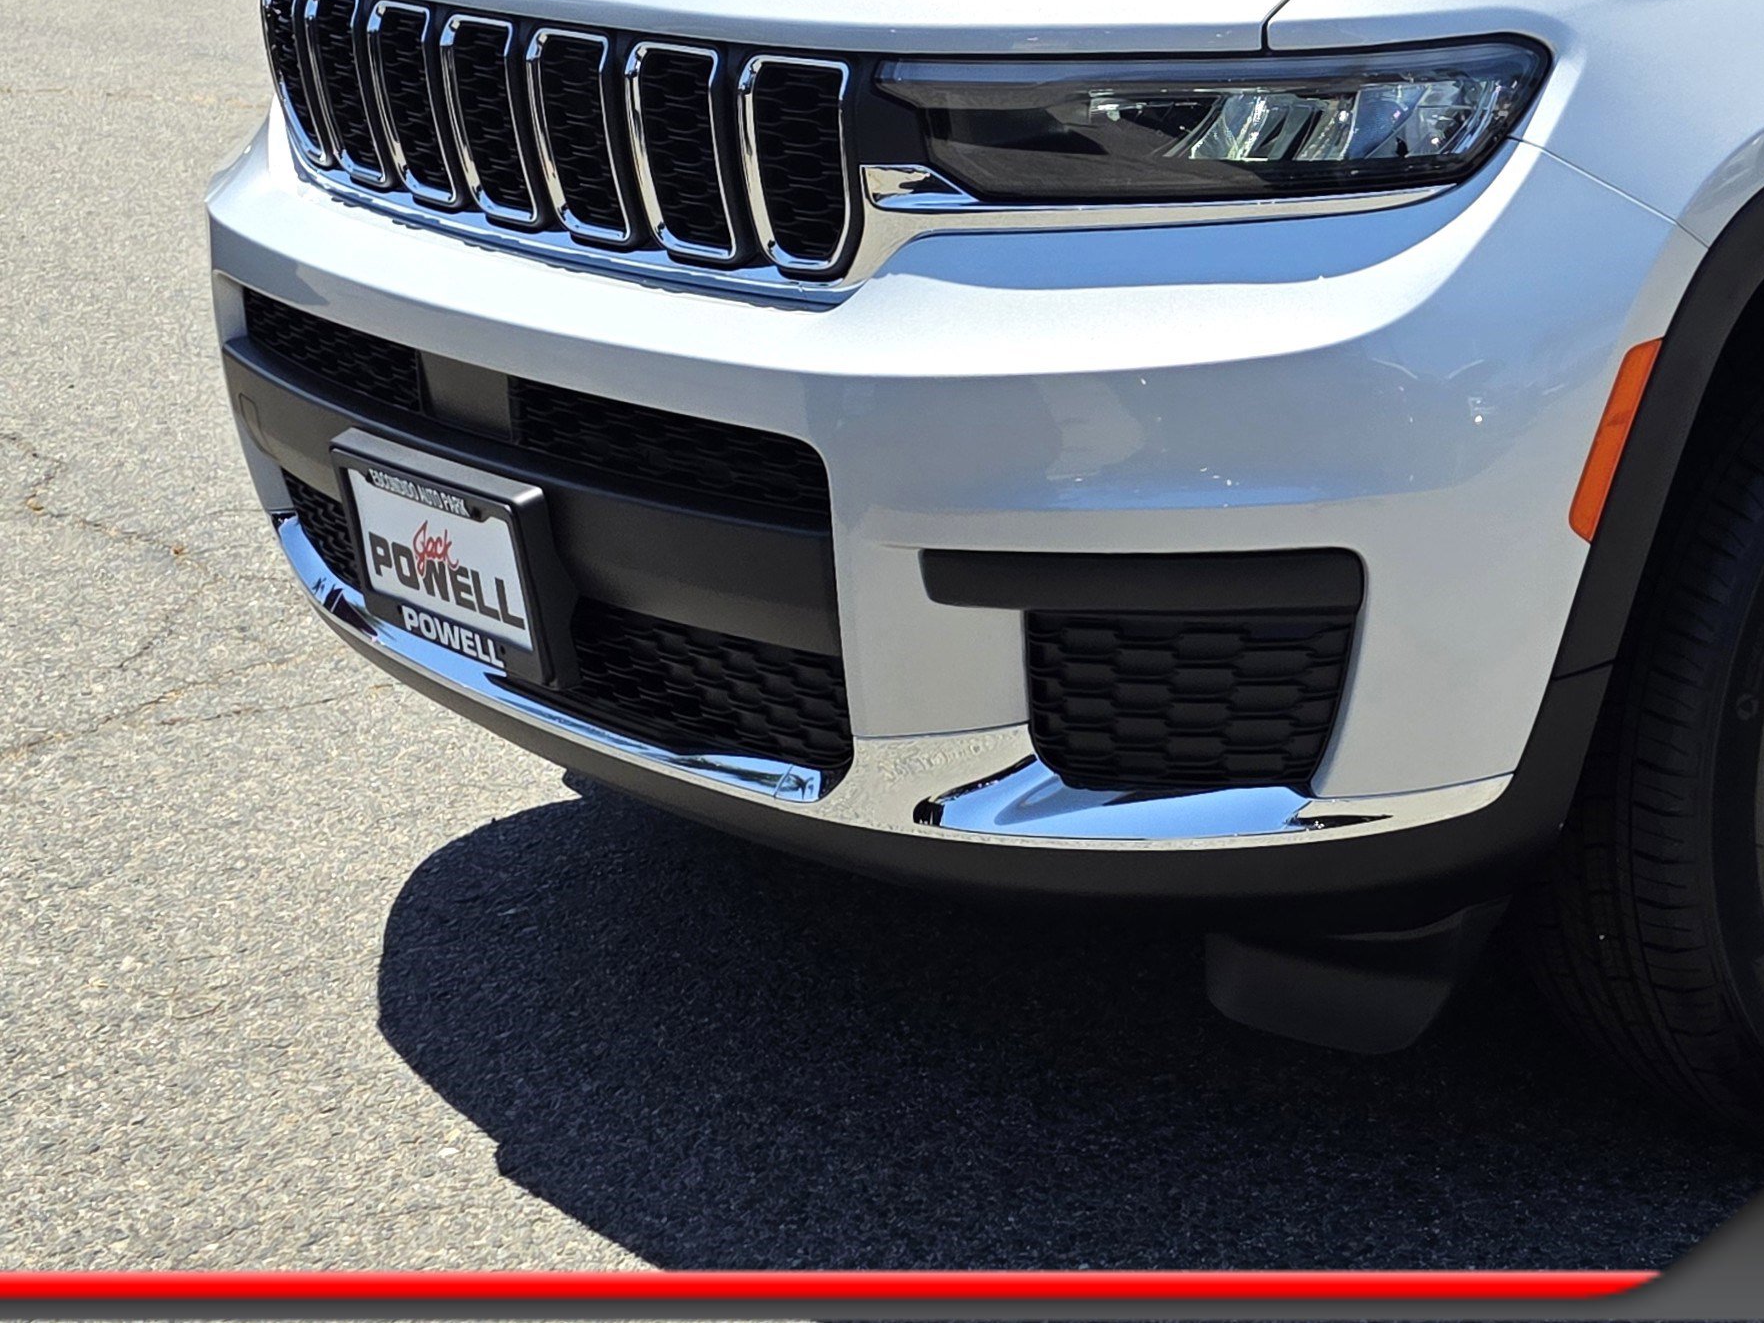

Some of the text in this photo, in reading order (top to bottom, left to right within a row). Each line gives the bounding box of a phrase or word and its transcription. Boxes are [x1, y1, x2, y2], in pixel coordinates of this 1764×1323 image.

[369, 531, 526, 631] POWELL
[412, 520, 460, 578] Jack
[401, 604, 506, 669] POWELL
